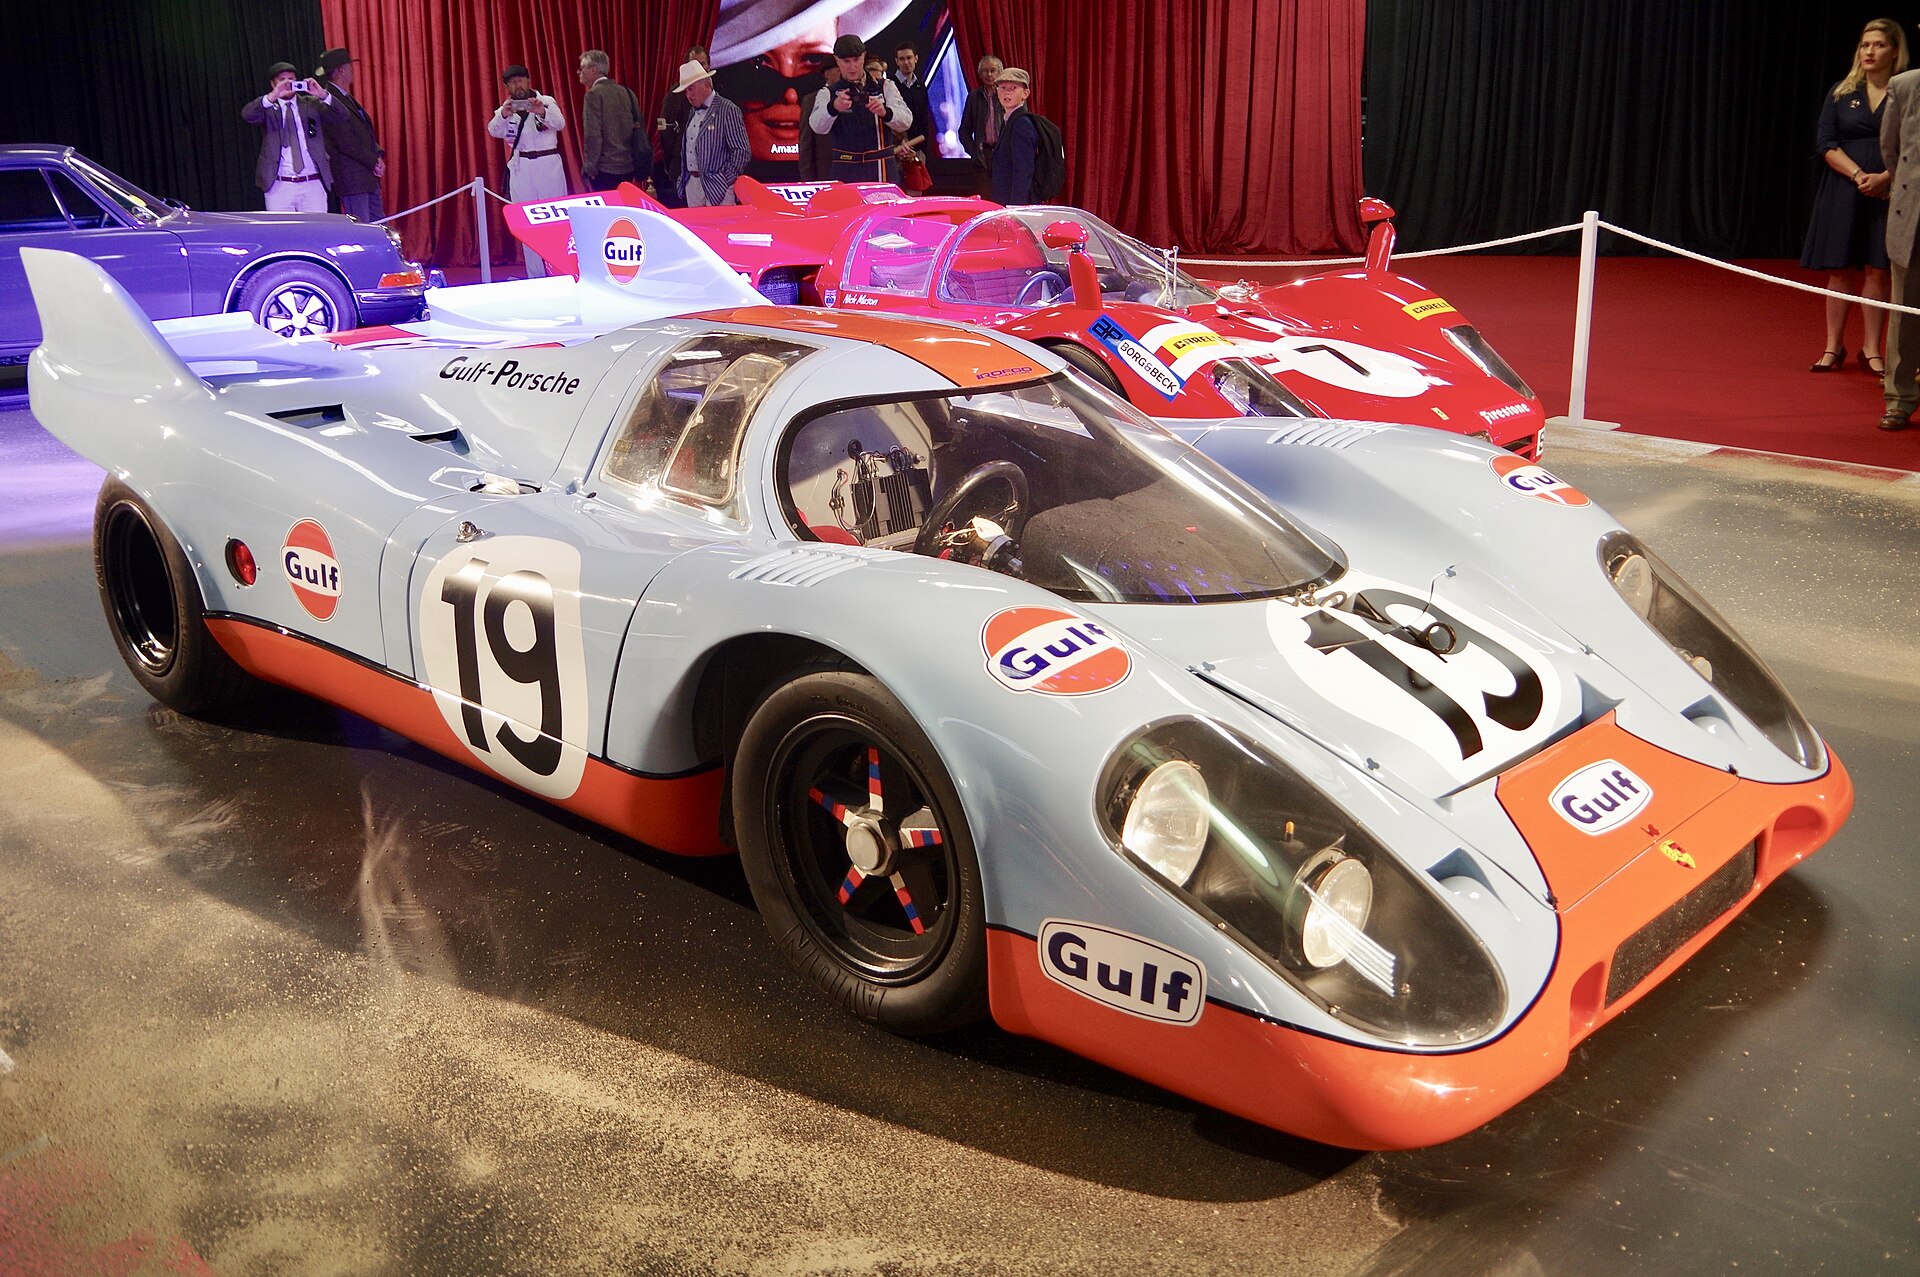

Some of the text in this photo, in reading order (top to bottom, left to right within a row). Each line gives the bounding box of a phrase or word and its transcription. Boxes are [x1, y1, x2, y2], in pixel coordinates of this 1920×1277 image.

[604, 241, 643, 262] Gulf
[1412, 301, 1451, 314] CARELL
[439, 356, 581, 395] Gulf-Porsche
[1119, 341, 1179, 393] BORG&BECK
[1292, 344, 1372, 378] 7
[1479, 402, 1531, 424] Firestone
[284, 550, 340, 591] Gulf
[441, 557, 563, 777] 19
[1000, 623, 1111, 680] Gulf
[1300, 588, 1544, 761] 19
[1561, 769, 1641, 824] Gulf
[1048, 931, 1193, 1013] Gulf
